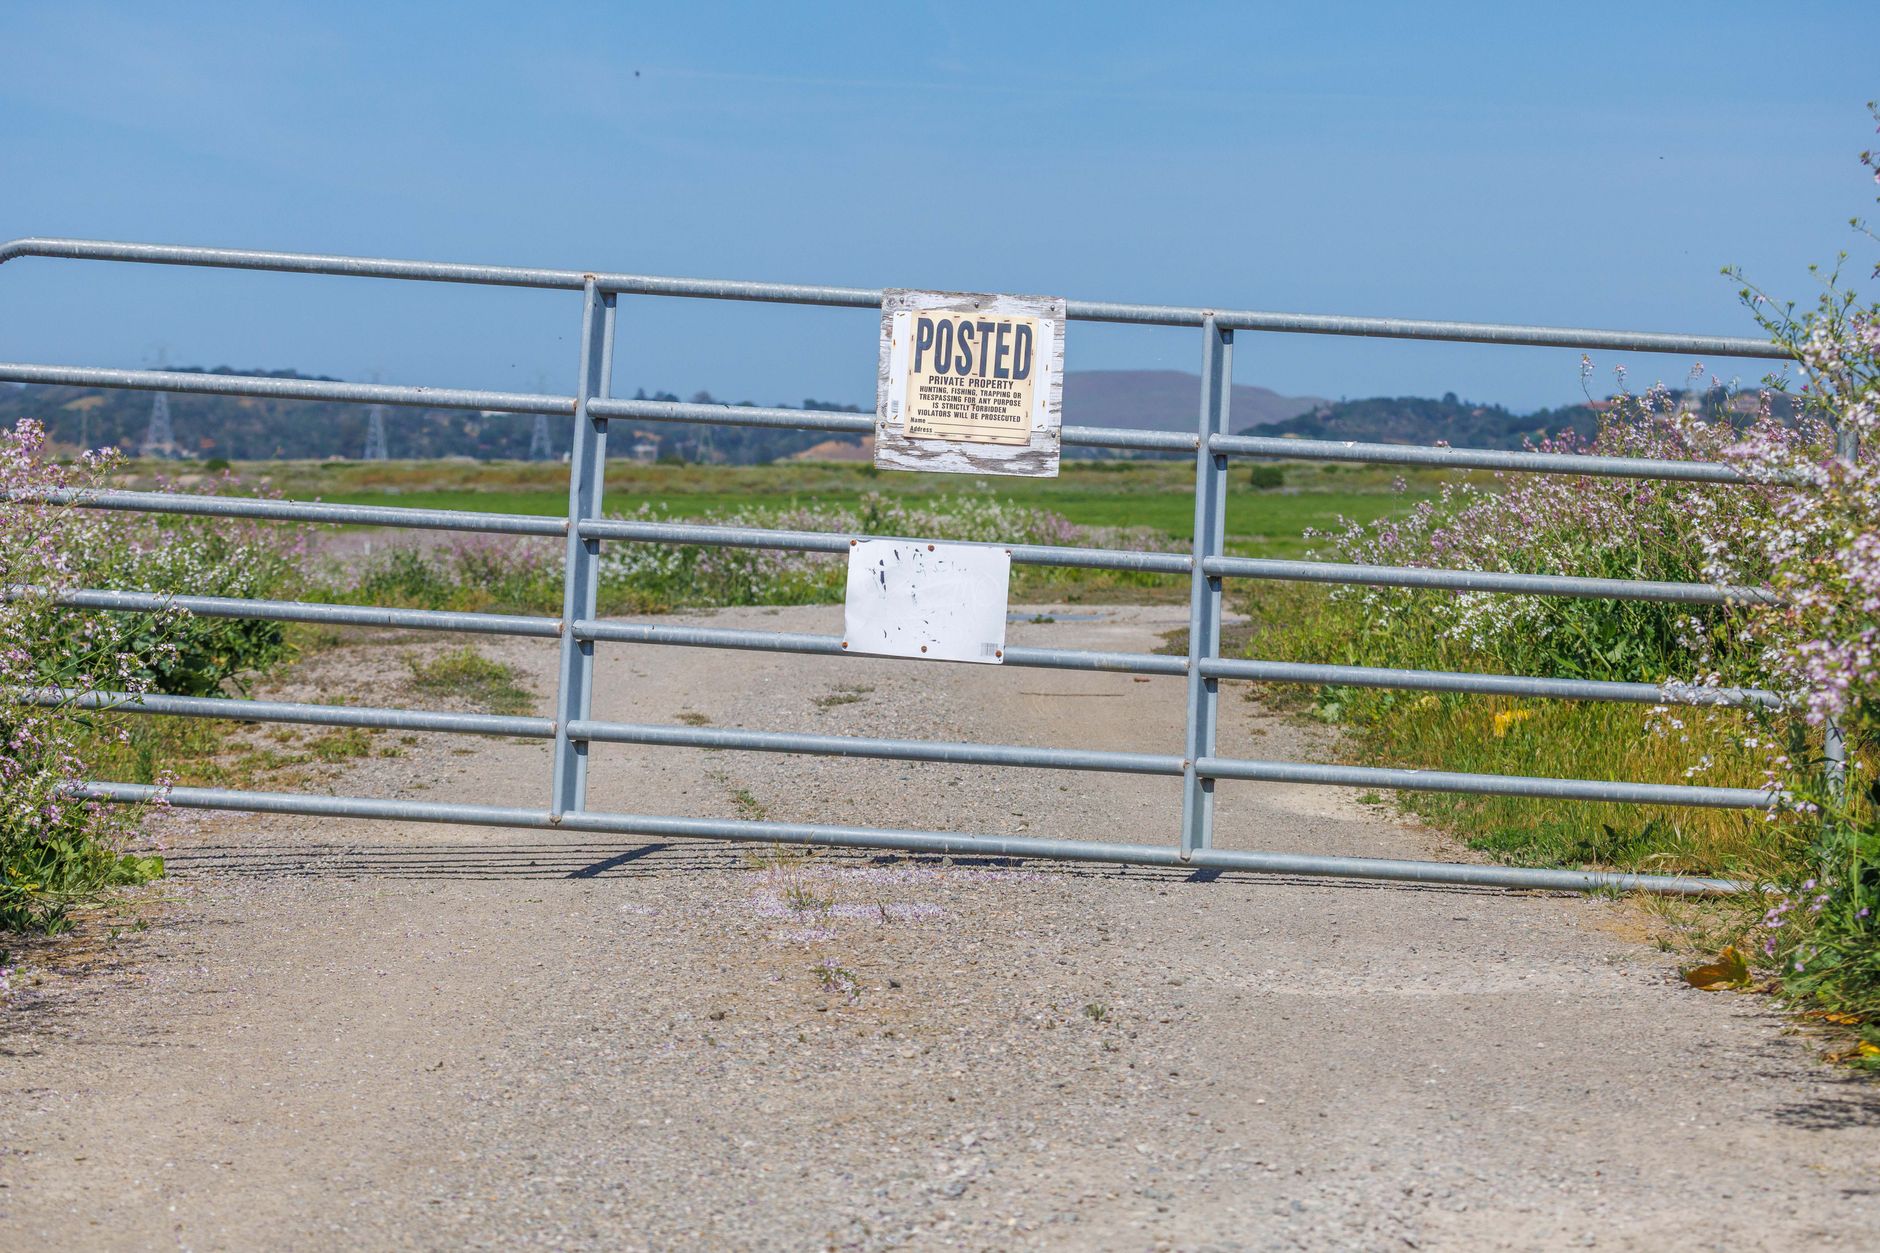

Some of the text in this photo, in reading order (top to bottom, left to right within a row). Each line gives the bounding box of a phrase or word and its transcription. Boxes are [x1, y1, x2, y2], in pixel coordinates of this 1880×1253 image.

[914, 318, 1033, 380] POSTED
[929, 376, 1014, 390] PRIVATE PROPERTY
[920, 394, 961, 402] TRESPASSING
[980, 390, 1010, 398] TRAPPING
[918, 409, 951, 417] VIOLATORS
[981, 414, 1020, 422] PROSECUTED
